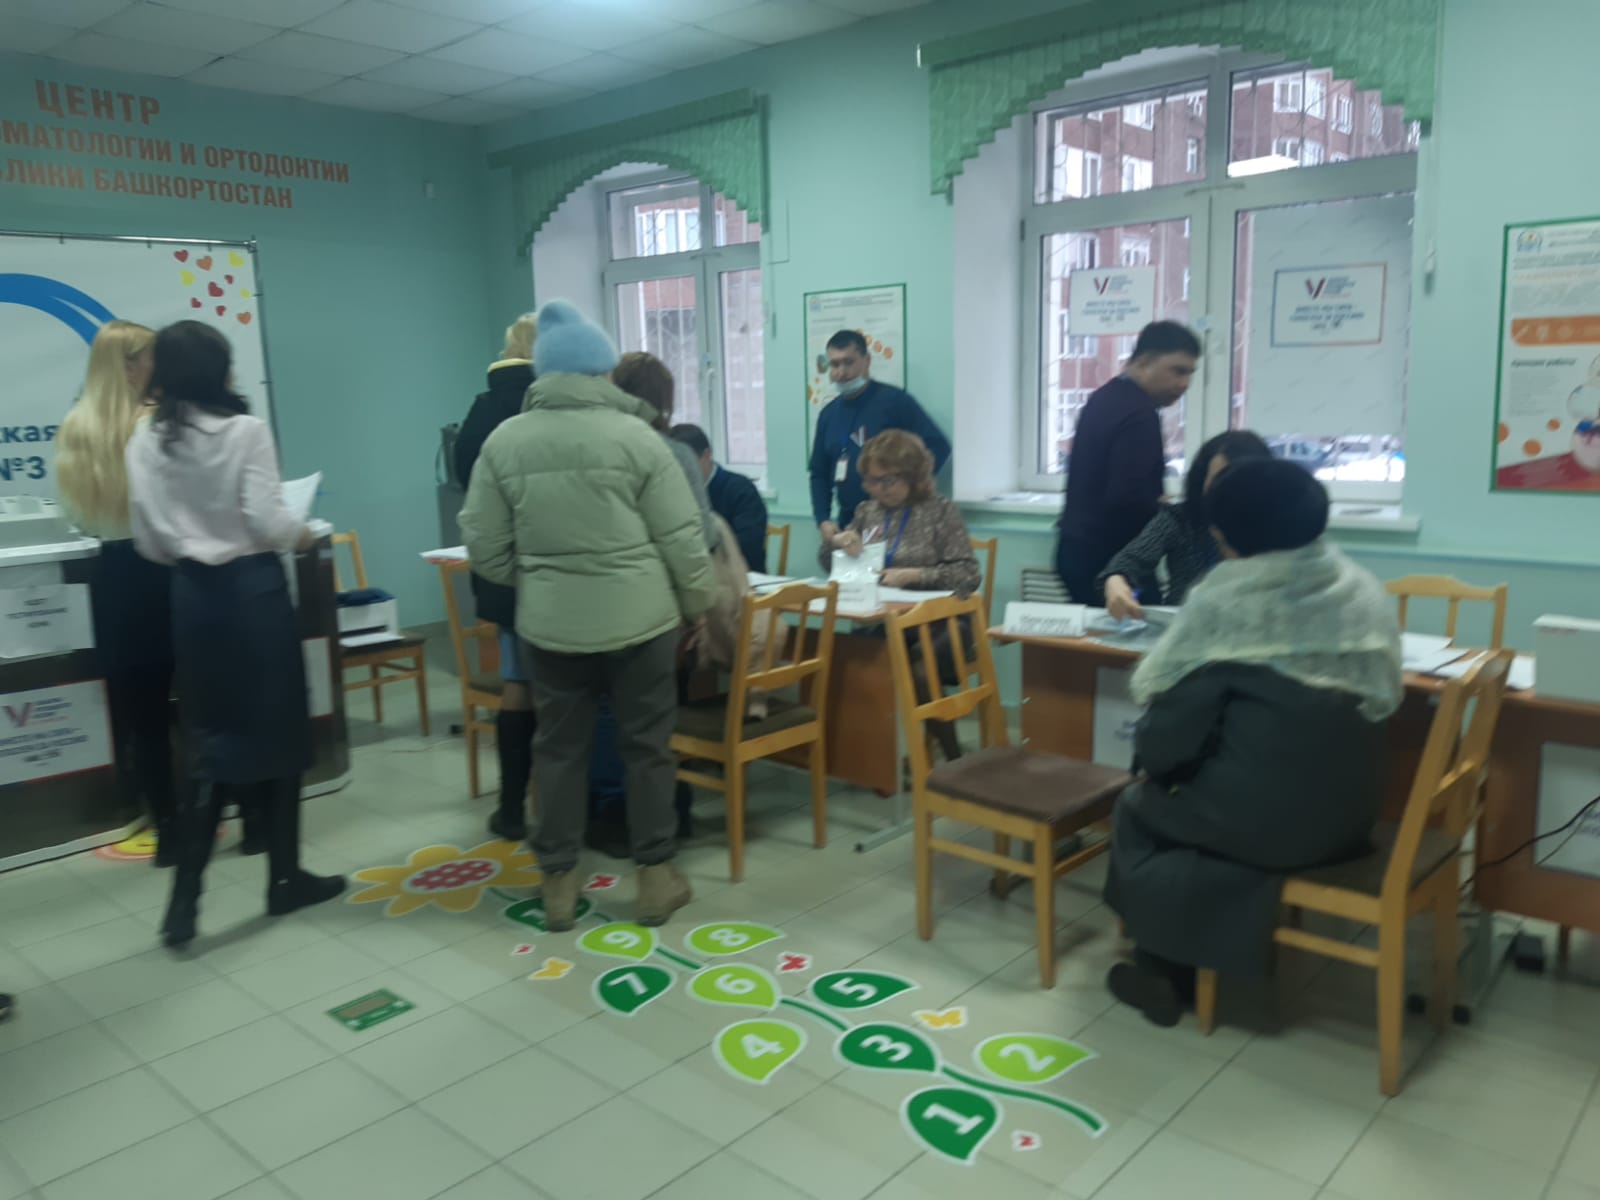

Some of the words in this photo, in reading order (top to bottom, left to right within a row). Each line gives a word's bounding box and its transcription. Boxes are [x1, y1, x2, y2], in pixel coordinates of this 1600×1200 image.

[35, 79, 160, 125] ЦЕНТР
[0, 119, 172, 163] МАТОЛОГИИ
[180, 142, 197, 166] И
[204, 145, 349, 184] ОРТОДОНТИИ
[0, 158, 85, 190] ЛИКИ
[94, 167, 293, 209] БАШКОРТОСТАН
[0, 425, 61, 443] кая
[603, 929, 642, 950] 9
[708, 927, 751, 948] 8
[607, 971, 650, 997] 7
[714, 972, 758, 996] 6
[829, 976, 879, 1002] 5
[741, 1031, 785, 1061] 4
[860, 1034, 913, 1062] 3
[998, 1043, 1057, 1073] 2
[922, 1102, 985, 1137] 1
